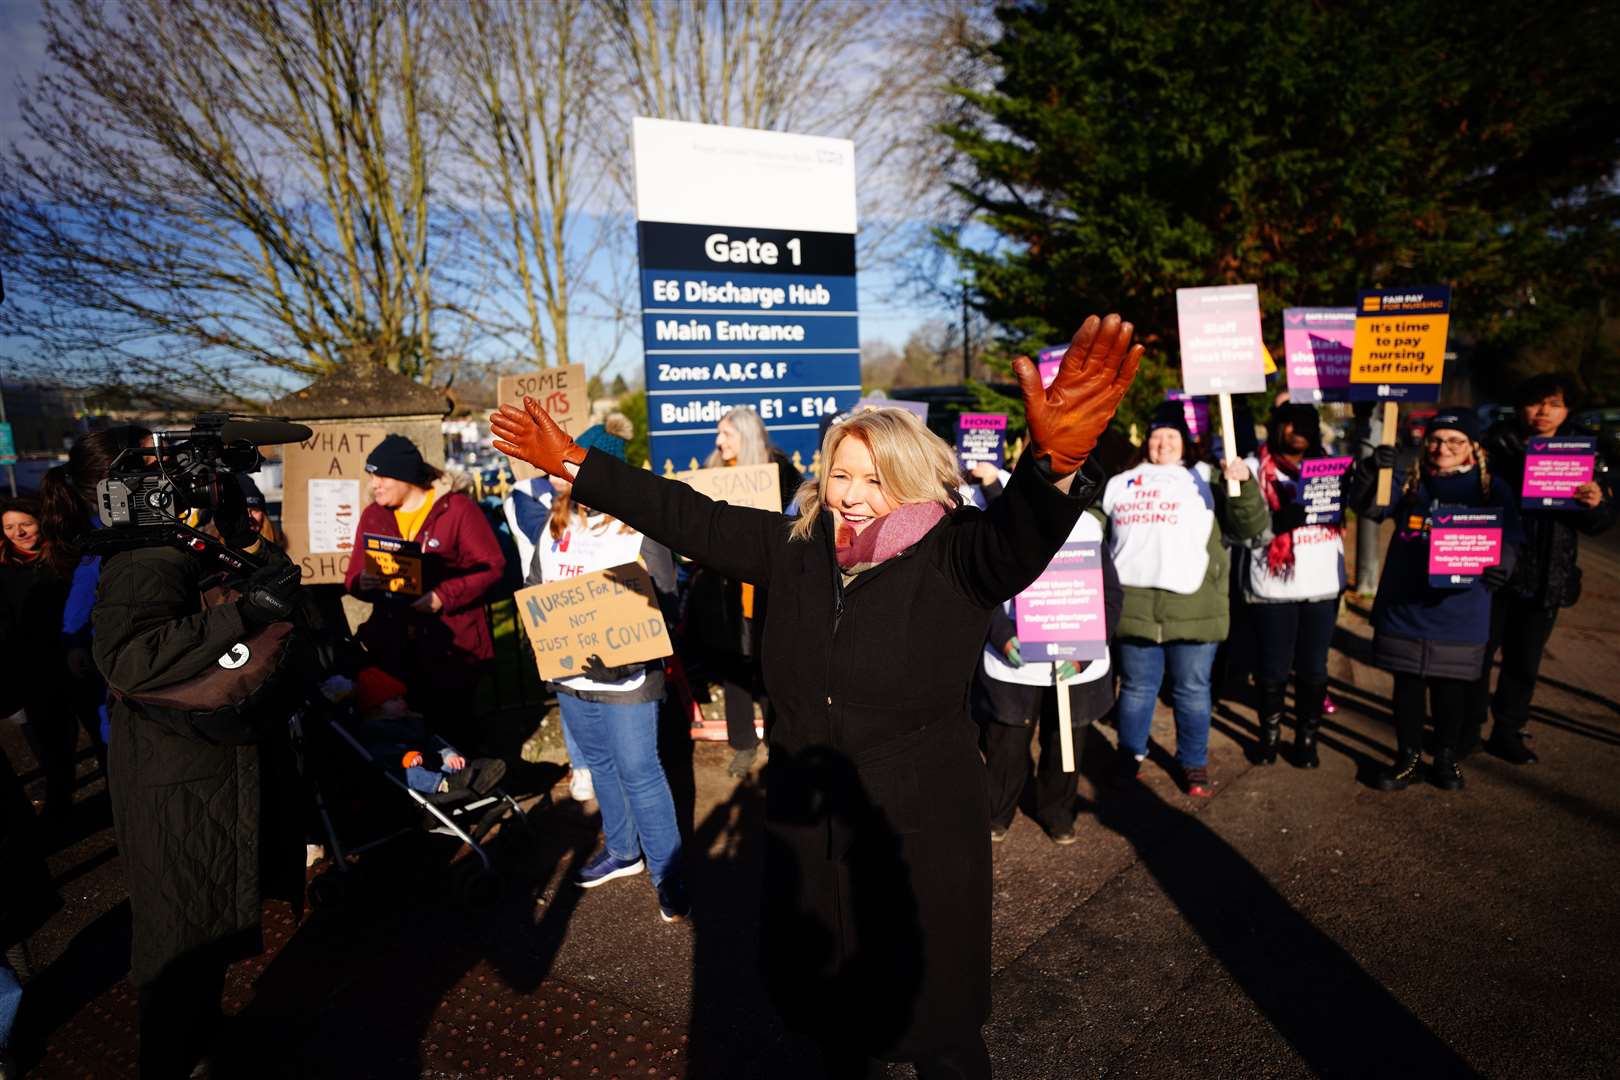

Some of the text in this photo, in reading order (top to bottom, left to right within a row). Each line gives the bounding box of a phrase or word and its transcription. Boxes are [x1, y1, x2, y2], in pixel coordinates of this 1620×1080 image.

[705, 233, 801, 266] Gate 1
[653, 280, 830, 308] E6 Discharge Hub
[1383, 294, 1423, 304] FAIR PAY
[656, 320, 805, 341] Main Entrance
[1371, 321, 1430, 333] It's time
[1307, 337, 1339, 349] Staff
[1376, 338, 1421, 348] to pay
[1369, 349, 1425, 361] nursing
[658, 363, 787, 381] Zones A,B,C & F
[1294, 366, 1321, 376] cost
[1359, 362, 1434, 375] staff fairly
[515, 371, 568, 397] SOME
[760, 399, 783, 419] E1
[788, 405, 798, 413] -
[801, 396, 837, 417] E14
[964, 418, 1001, 426] HONK
[301, 432, 370, 453] WHAT
[329, 457, 342, 475] A
[1306, 463, 1347, 473] HONK
[712, 470, 772, 498] STAND
[1135, 490, 1160, 499] THE
[1113, 501, 1180, 514] VOICE OF
[1114, 513, 1178, 526] NURSING
[559, 564, 584, 576] THE
[526, 577, 641, 628] NURSES FOR LIFE
[569, 610, 597, 629] NOT
[536, 618, 662, 652] JUST FOR COVID
